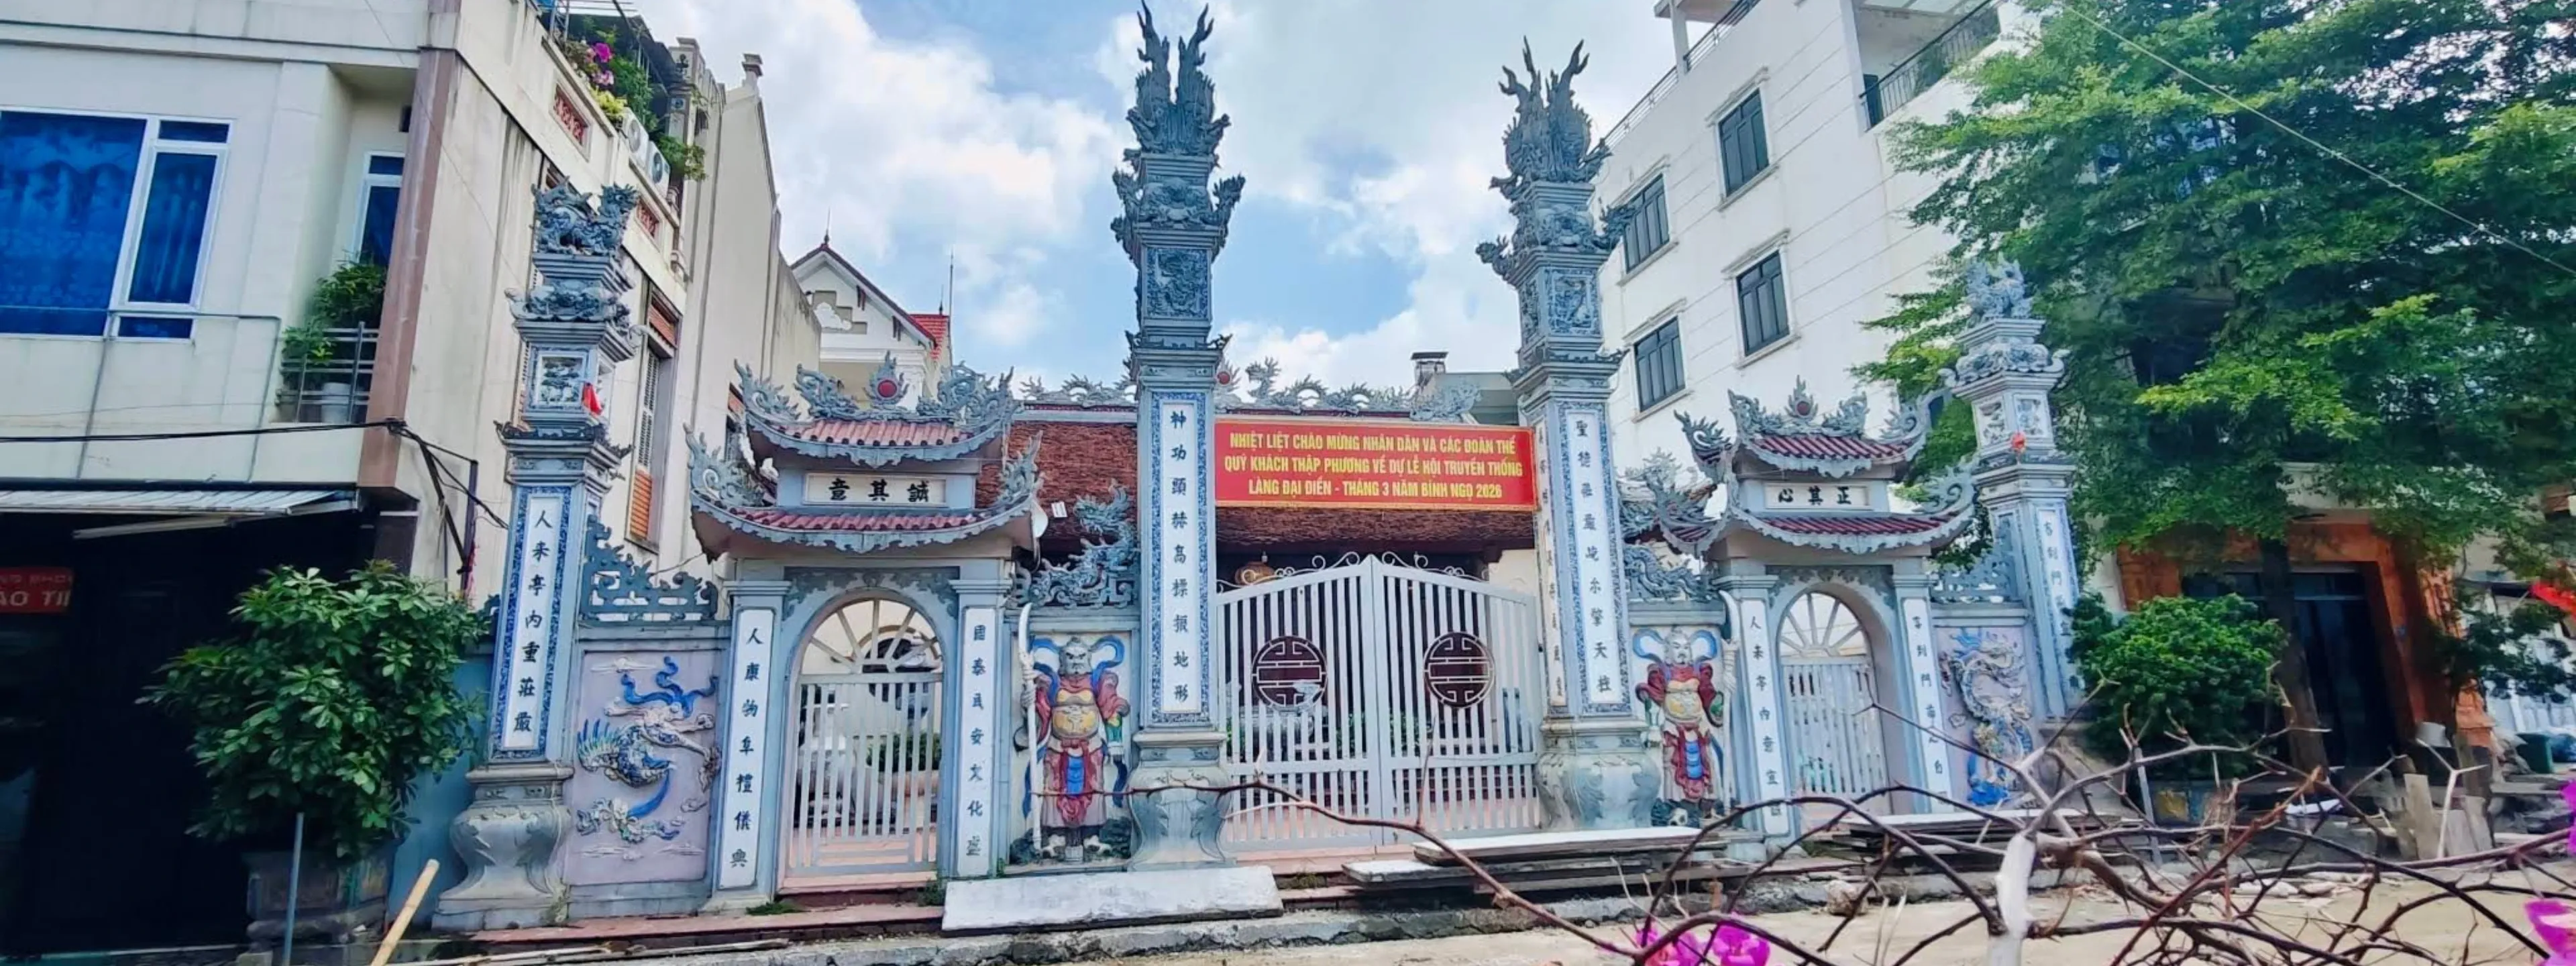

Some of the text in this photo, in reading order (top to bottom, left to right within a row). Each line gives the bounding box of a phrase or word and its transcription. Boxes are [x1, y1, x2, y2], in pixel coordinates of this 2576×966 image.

[1230, 430, 1516, 455] NHIỆT LIỆT CHÀO MỪNG NHÂN DÂN VÀ CÁC ĐOÀN THỂ
[1224, 453, 1523, 478] QUÝ KHÁCH THẬP PHƯƠNG VỀ DỰ LỄ HỘI TRUYỀN THỐNG
[1248, 476, 1280, 495] LÀNG
[1282, 479, 1301, 499] ĐẠI
[1342, 478, 1380, 496] THÁNG
[1382, 482, 1389, 496] 3
[1392, 479, 1418, 497] NĂM
[1421, 480, 1448, 498] BÍNH
[1450, 482, 1474, 501] NGỌ
[1476, 483, 1503, 498] 2026
